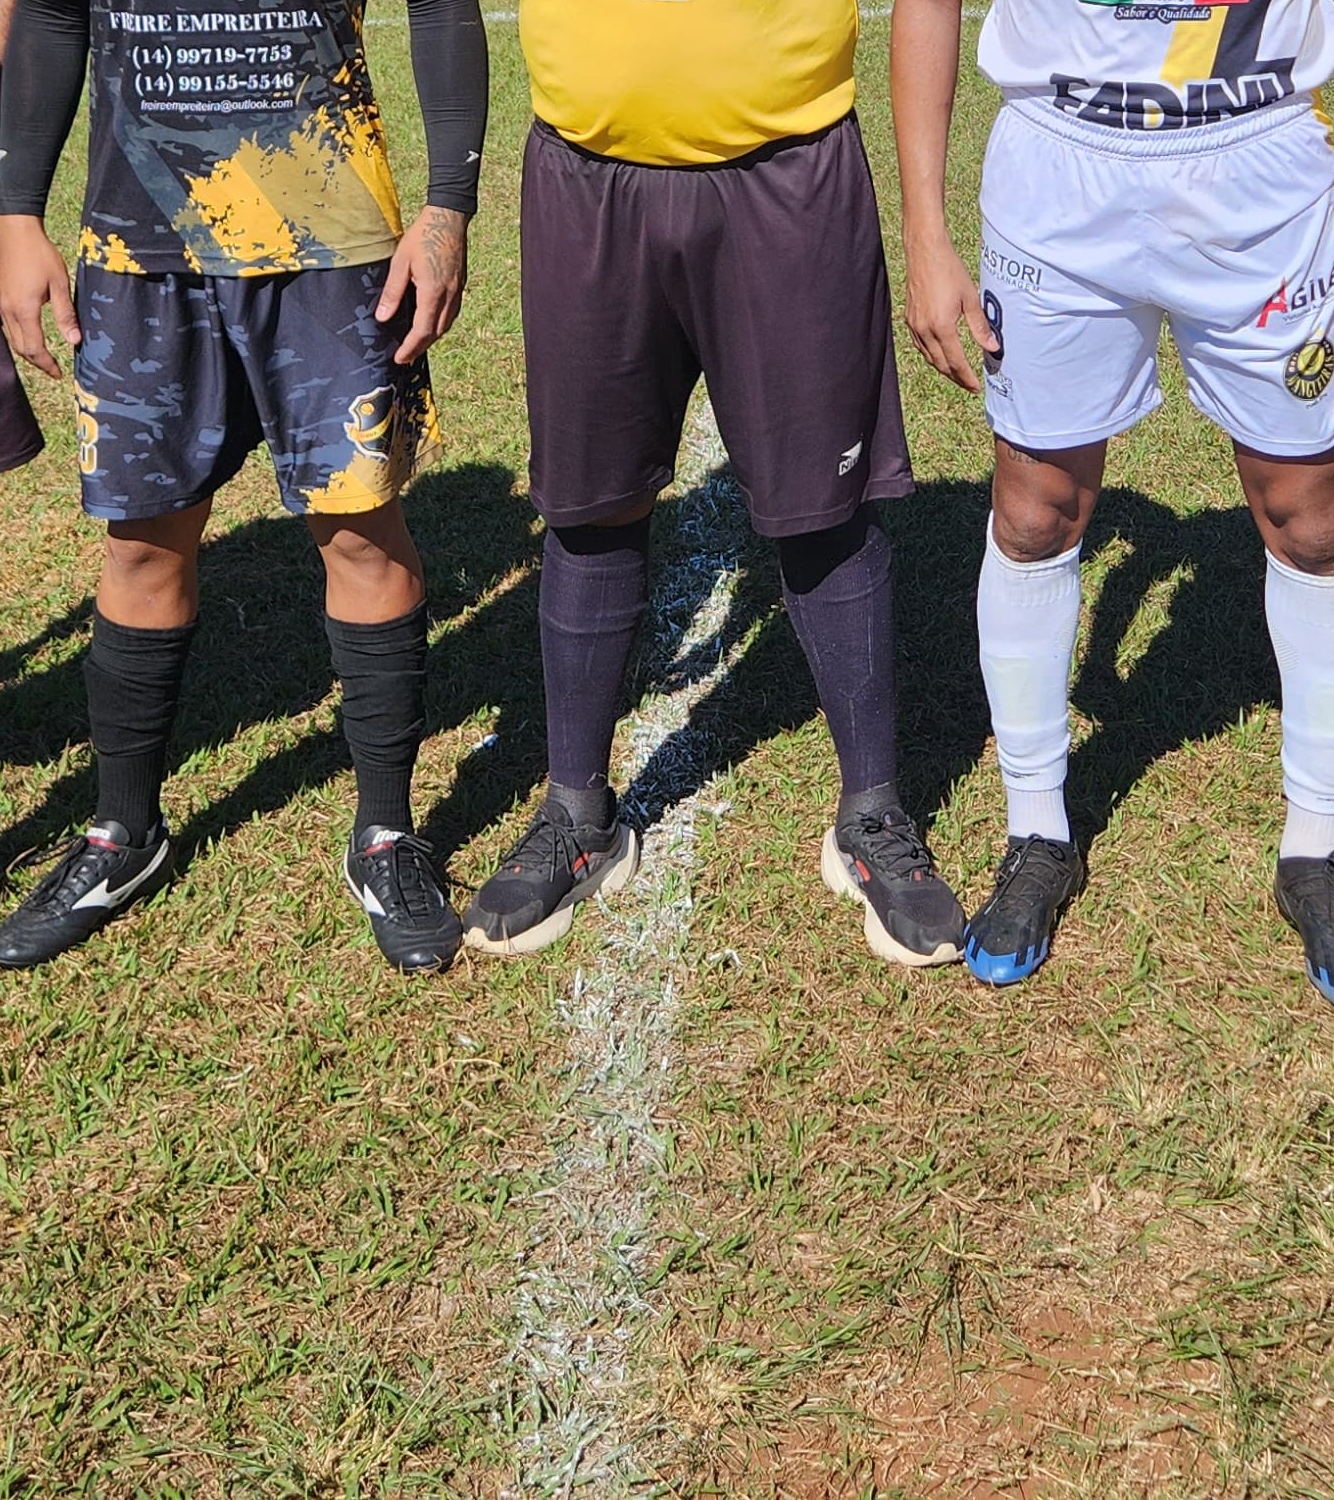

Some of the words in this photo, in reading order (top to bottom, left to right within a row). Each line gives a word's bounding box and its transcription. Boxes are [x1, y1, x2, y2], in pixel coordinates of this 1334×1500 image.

[110, 11, 171, 32] FREIRE
[177, 9, 323, 32] EMPREITEIRA
[1116, 6, 1147, 19] Sabor
[1158, 6, 1211, 23] Qualidade
[132, 45, 172, 70] (14)
[176, 44, 292, 64] 99719-7753
[135, 72, 174, 97] (14)
[179, 72, 295, 92] 99155-5546
[141, 99, 293, 113] freireempreiteira@outlook.com
